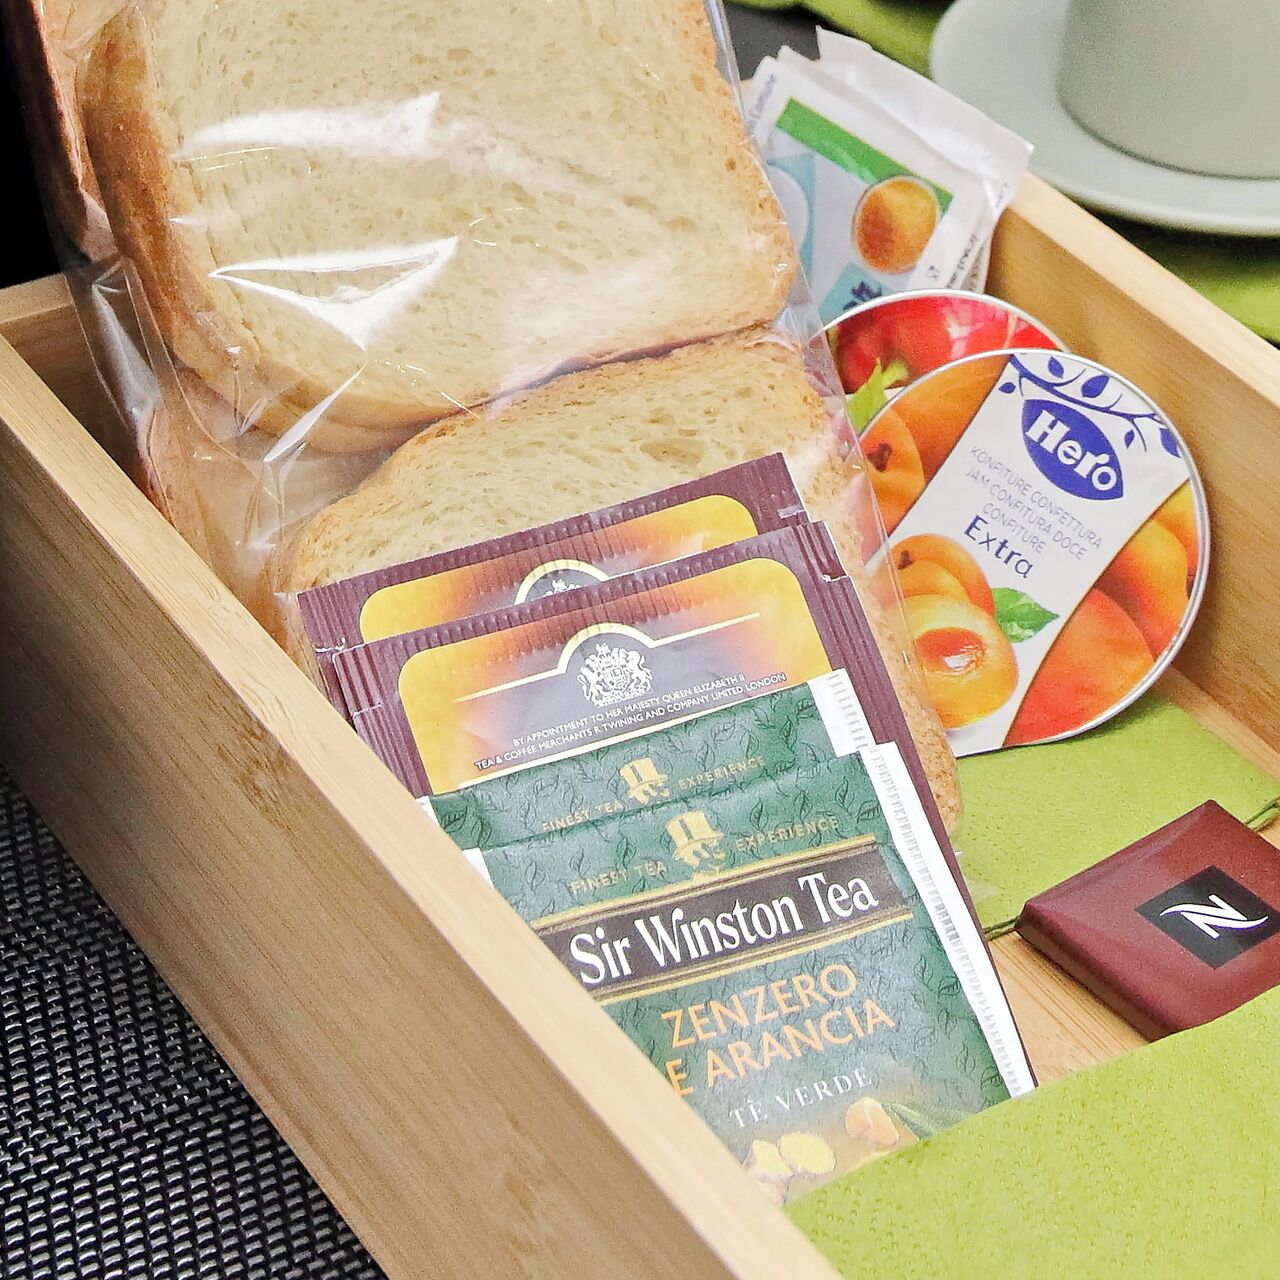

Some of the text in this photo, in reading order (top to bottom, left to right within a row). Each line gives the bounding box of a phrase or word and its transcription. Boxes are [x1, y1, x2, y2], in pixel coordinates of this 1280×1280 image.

[1025, 409, 1118, 491] Hero
[965, 468, 1088, 560] JAM CONFITURA DOCE
[970, 446, 1103, 550] KONFITURE CONFETTURA
[982, 502, 1047, 554] CONFITURE
[963, 514, 1034, 579] Extra
[475, 759, 495, 771] TEA
[496, 755, 503, 765] &
[504, 745, 538, 761] COFFEE
[538, 728, 593, 750] MERCHANTS
[601, 714, 644, 733] TWINING
[645, 707, 666, 721] AND
[667, 693, 709, 713] COMPANY
[710, 685, 744, 701] LIMITED
[745, 672, 788, 692] LONDON
[513, 736, 525, 747] BY
[526, 718, 589, 743] APPOINTMENT
[591, 713, 604, 723] TO
[605, 708, 623, 721] HER
[624, 697, 661, 715] MAJESTY
[662, 688, 692, 704] QUEEN
[693, 676, 738, 695] ELIZABETH
[542, 755, 766, 832] FINEST TEA EXPERIENCE
[571, 816, 840, 895] FINEST TEA EXPERIENCE
[570, 872, 879, 985] Sir Winston Tea
[661, 963, 859, 1049] ZENZERO
[665, 998, 897, 1097] E ARANCIA
[775, 1067, 873, 1112] VERDE
